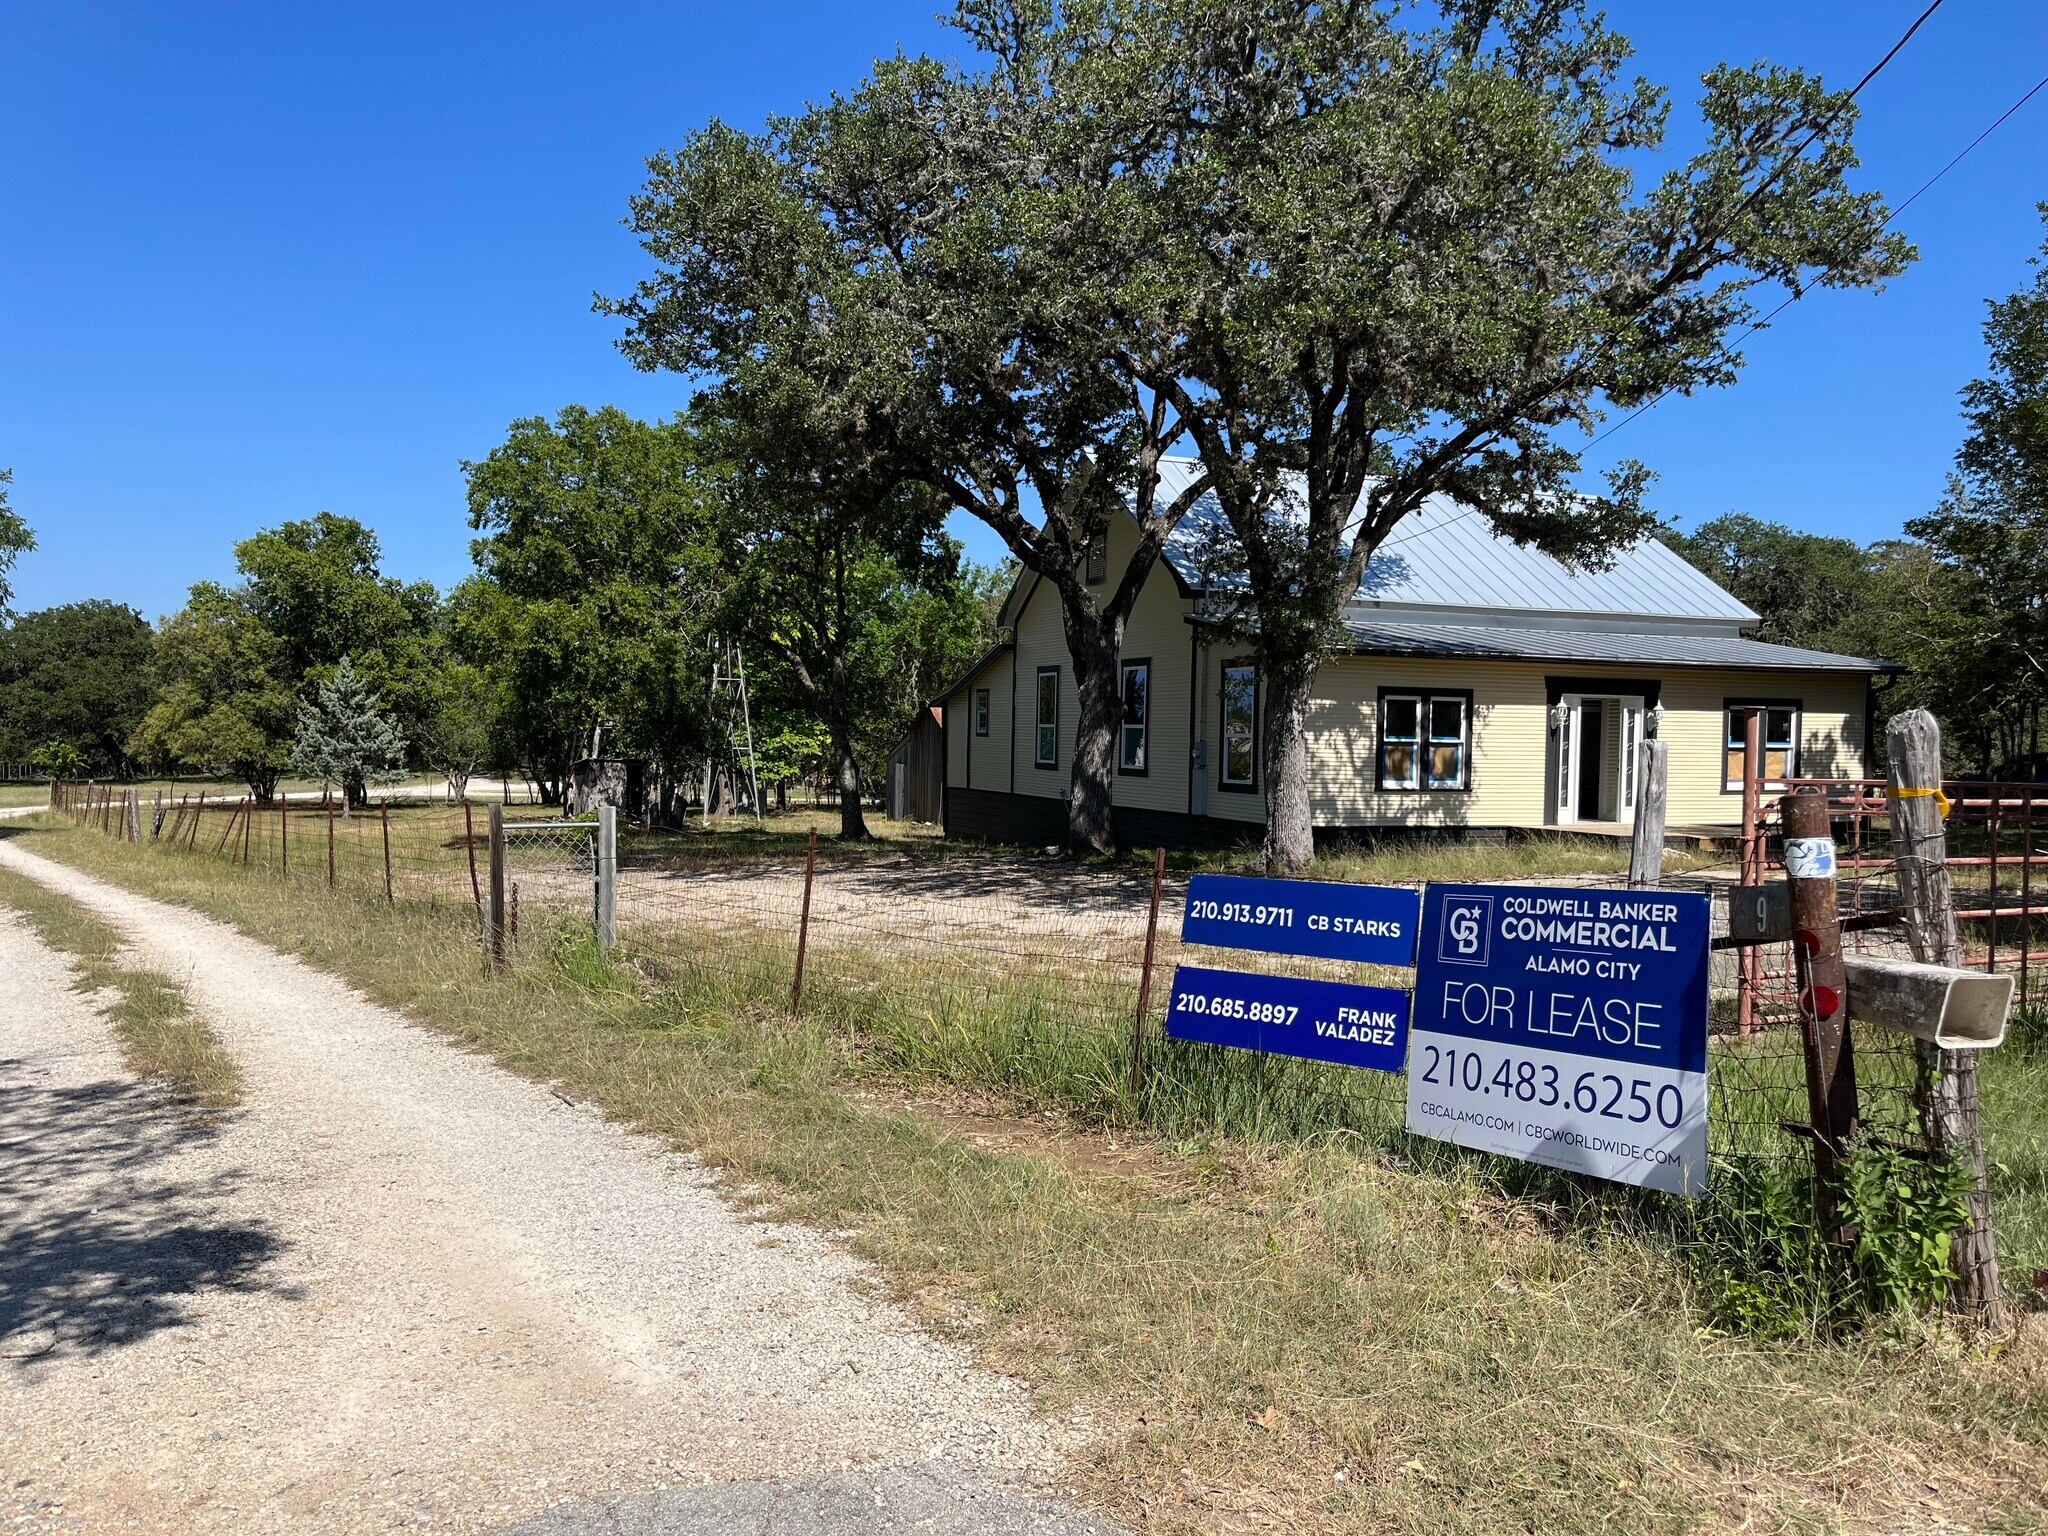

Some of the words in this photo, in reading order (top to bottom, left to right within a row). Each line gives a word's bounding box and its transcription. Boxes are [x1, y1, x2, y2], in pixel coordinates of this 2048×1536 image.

[1190, 900, 1293, 927] 210.913.9711
[1307, 915, 1329, 931] CB
[1333, 917, 1401, 938] STARKS
[1503, 897, 1594, 918] COLDWELL
[1600, 901, 1677, 923] BANKER
[1756, 896, 1767, 933] 9
[1501, 916, 1677, 952] COMMERCIAL
[1525, 955, 1590, 976] ALAMO
[1595, 960, 1641, 981] CITY
[1176, 993, 1298, 1026] 210.685.8897
[1338, 1007, 1397, 1029] FRANK
[1442, 980, 1515, 1029] FOR
[1527, 990, 1662, 1049] LEASE
[1315, 1020, 1395, 1046] VALADEZ
[1421, 1045, 1683, 1129] 210.483.6250
[1421, 1101, 1514, 1133] CBCALAMO.COM
[1525, 1124, 1681, 1168] CBCWORLDWIDE.COM
